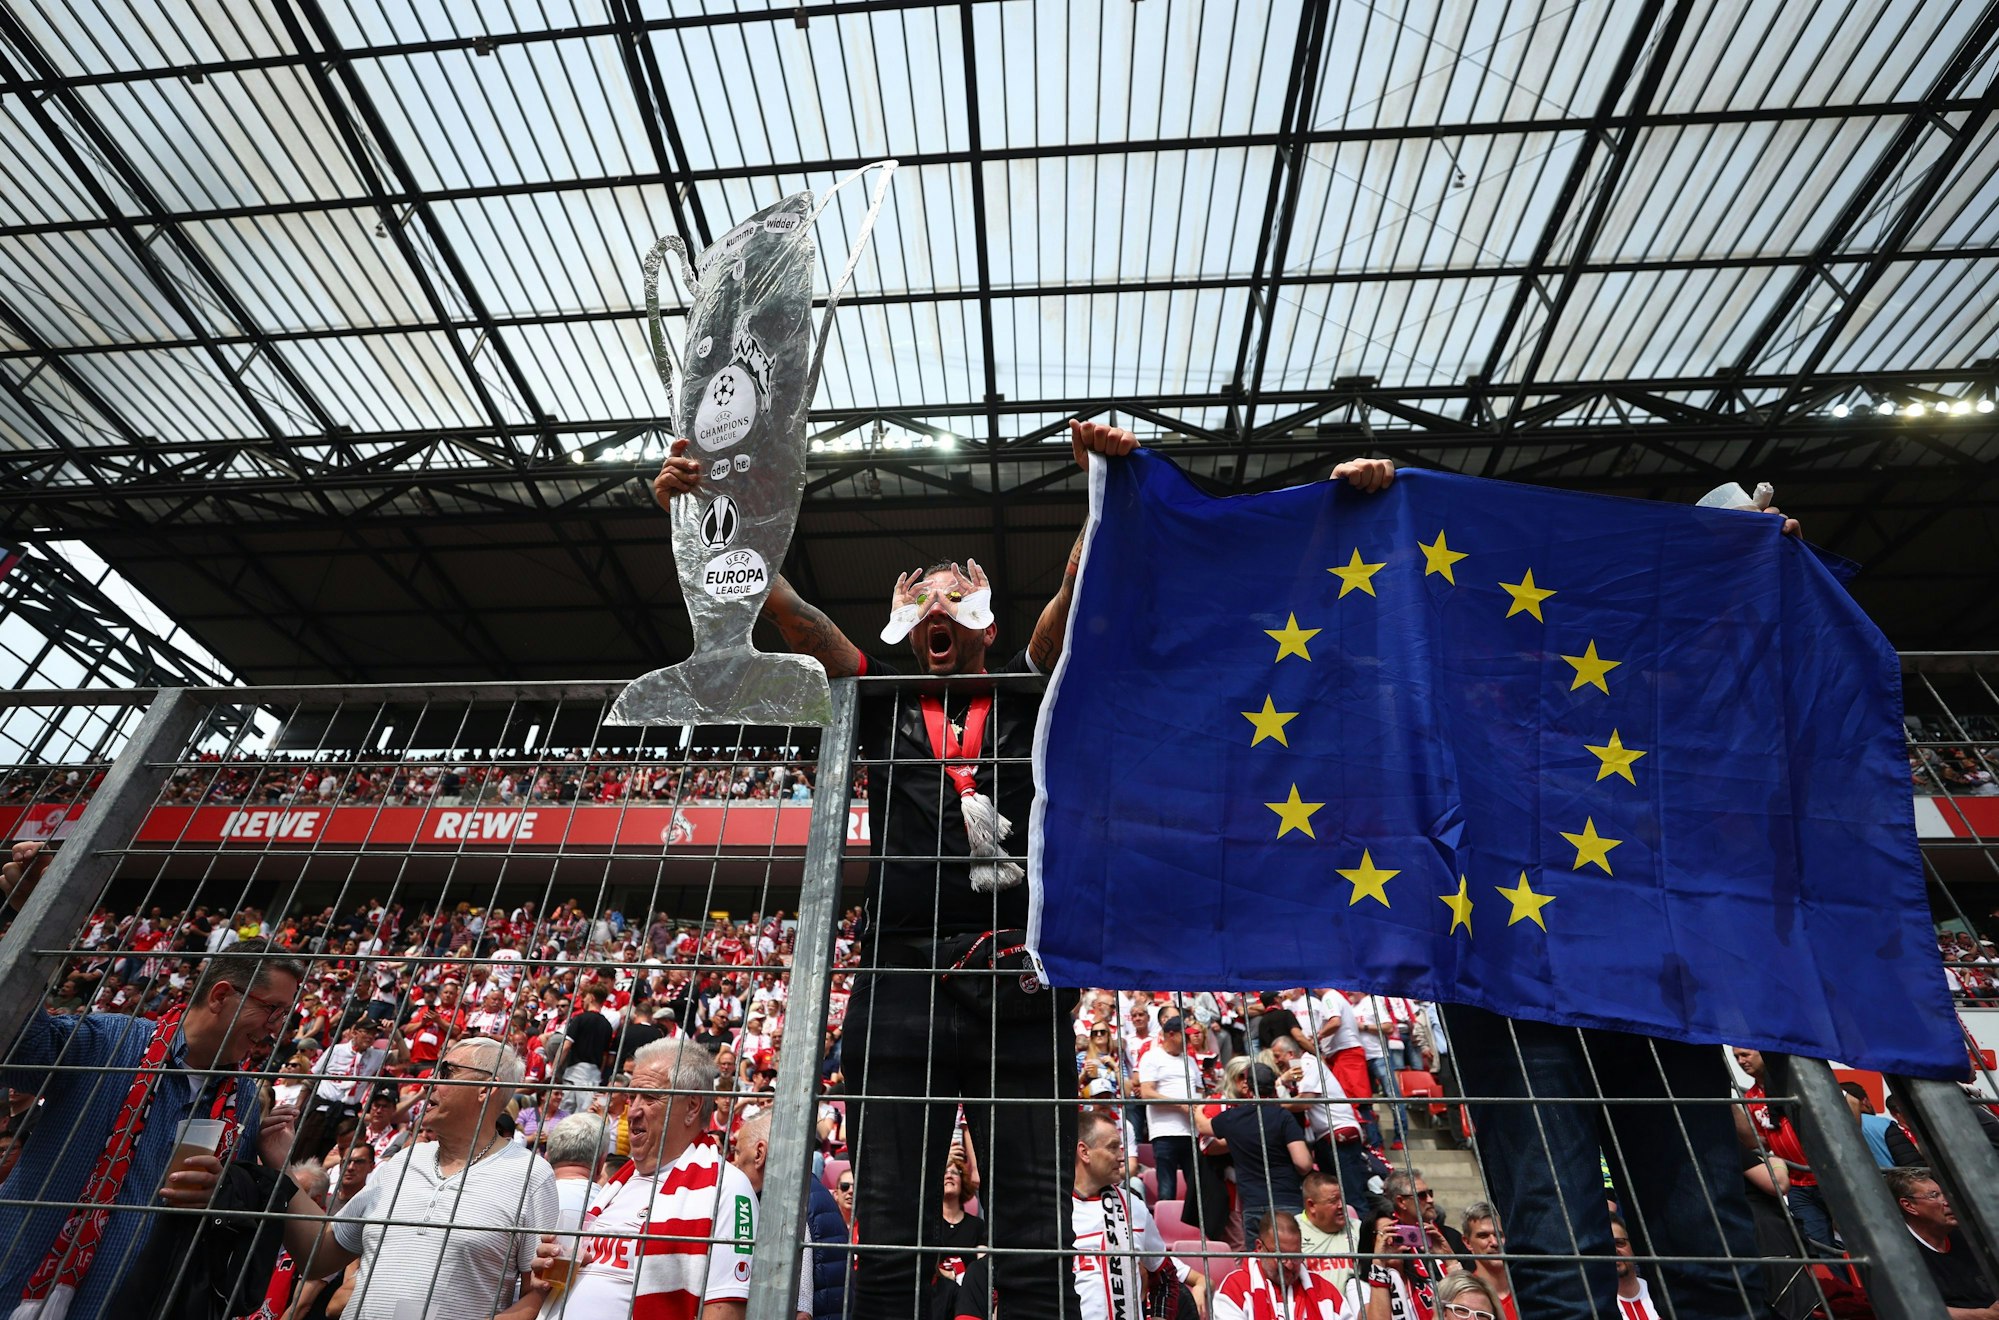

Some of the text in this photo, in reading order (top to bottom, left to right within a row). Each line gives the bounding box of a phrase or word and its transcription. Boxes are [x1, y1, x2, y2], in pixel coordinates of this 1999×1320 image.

[726, 226, 754, 249] kumme
[766, 217, 796, 229] widder
[700, 416, 749, 440] CHAMPIONS
[713, 431, 737, 445] LEAGUE
[711, 463, 730, 477] oder
[725, 553, 750, 566] UEFA
[705, 568, 764, 585] EUROPA
[715, 584, 751, 595] LEAGUE
[219, 811, 320, 838] REWE
[434, 811, 537, 839] REWE
[738, 1200, 750, 1250] DEVK
